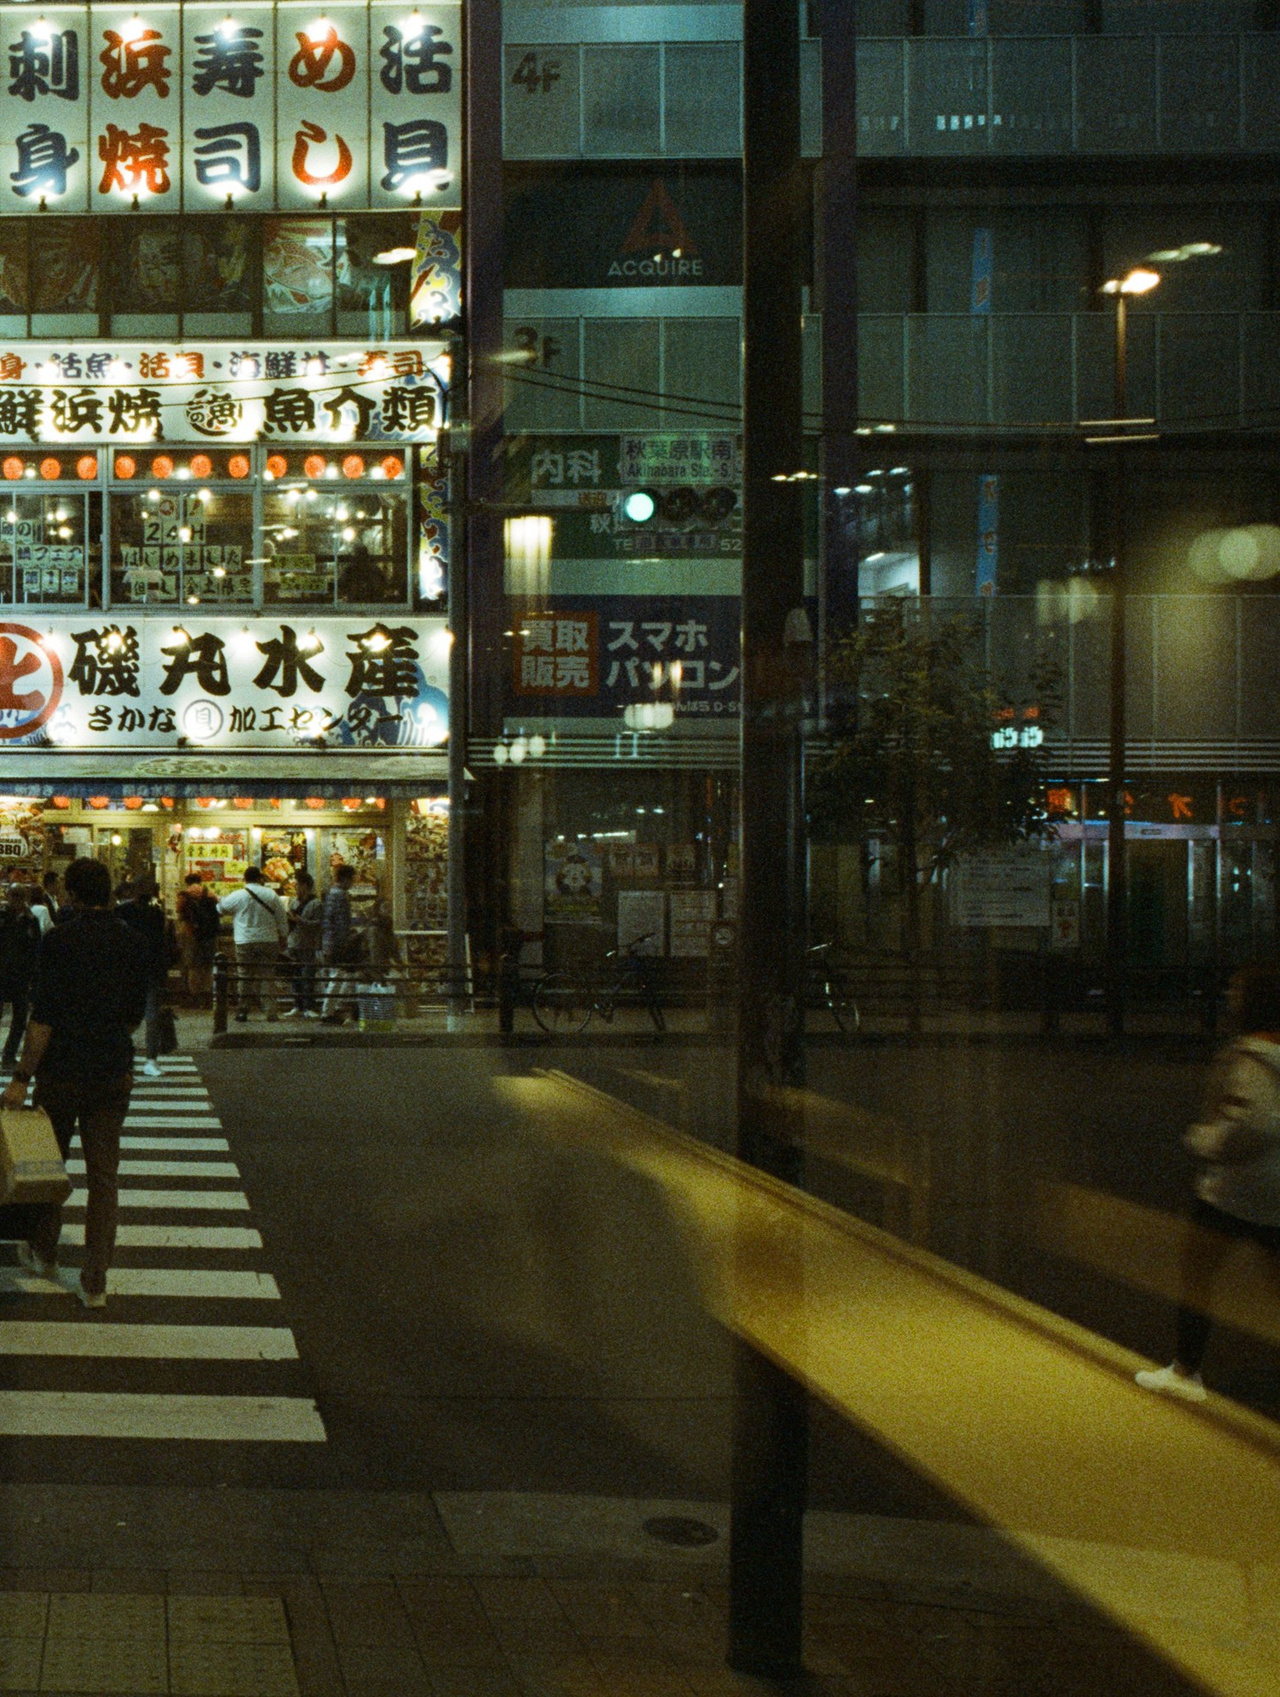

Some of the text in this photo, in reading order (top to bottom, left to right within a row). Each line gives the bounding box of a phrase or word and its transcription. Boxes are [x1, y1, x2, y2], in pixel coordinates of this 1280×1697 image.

[511, 52, 561, 94] 4F
[8, 29, 80, 197] 刺身
[98, 27, 172, 195] 浜焼
[192, 27, 264, 194] 寿司
[289, 26, 356, 187] めし
[380, 24, 453, 192] 活貝
[607, 258, 704, 277] ACQUIRE
[262, 387, 439, 435] 魚介類
[530, 449, 602, 485] 内科
[124, 549, 240, 568] はじめました
[67, 622, 420, 698] 磯丸水産
[521, 619, 709, 653] 買取 スマホ
[520, 655, 740, 692] 販売 パソコン
